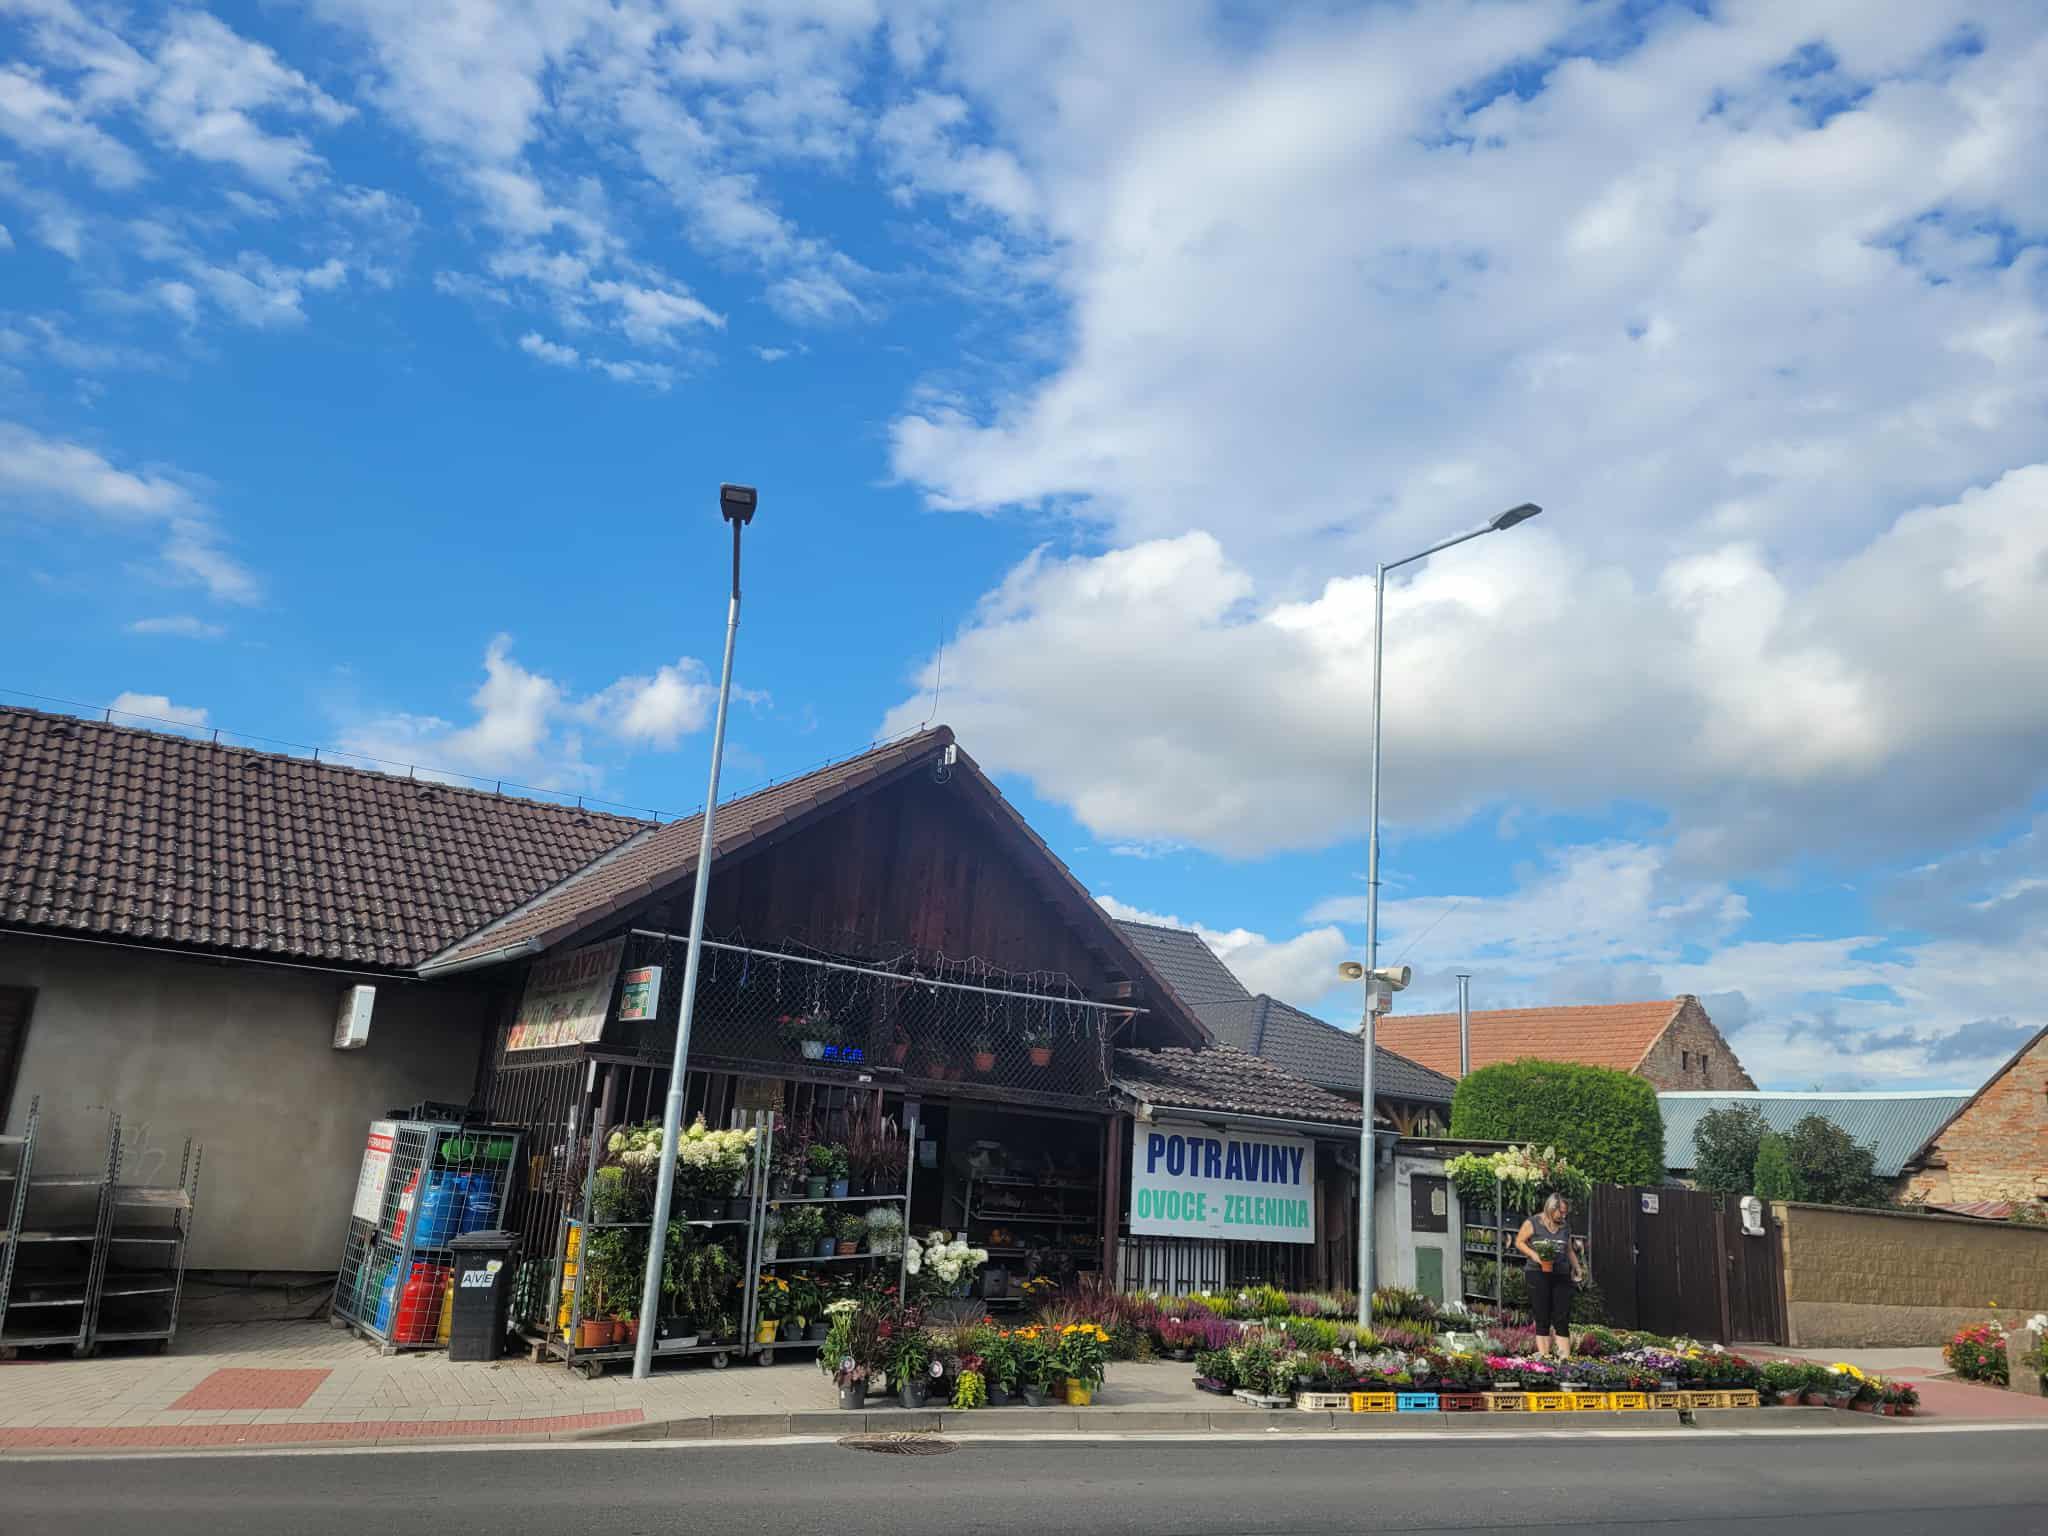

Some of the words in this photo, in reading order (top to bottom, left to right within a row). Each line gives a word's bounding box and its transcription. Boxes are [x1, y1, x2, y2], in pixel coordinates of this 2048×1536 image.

[1147, 1133, 1304, 1185] POTRAVINY
[1138, 1188, 1207, 1221] OVOCE
[1223, 1194, 1309, 1229] ZELENINA
[463, 1272, 495, 1284] AVE
